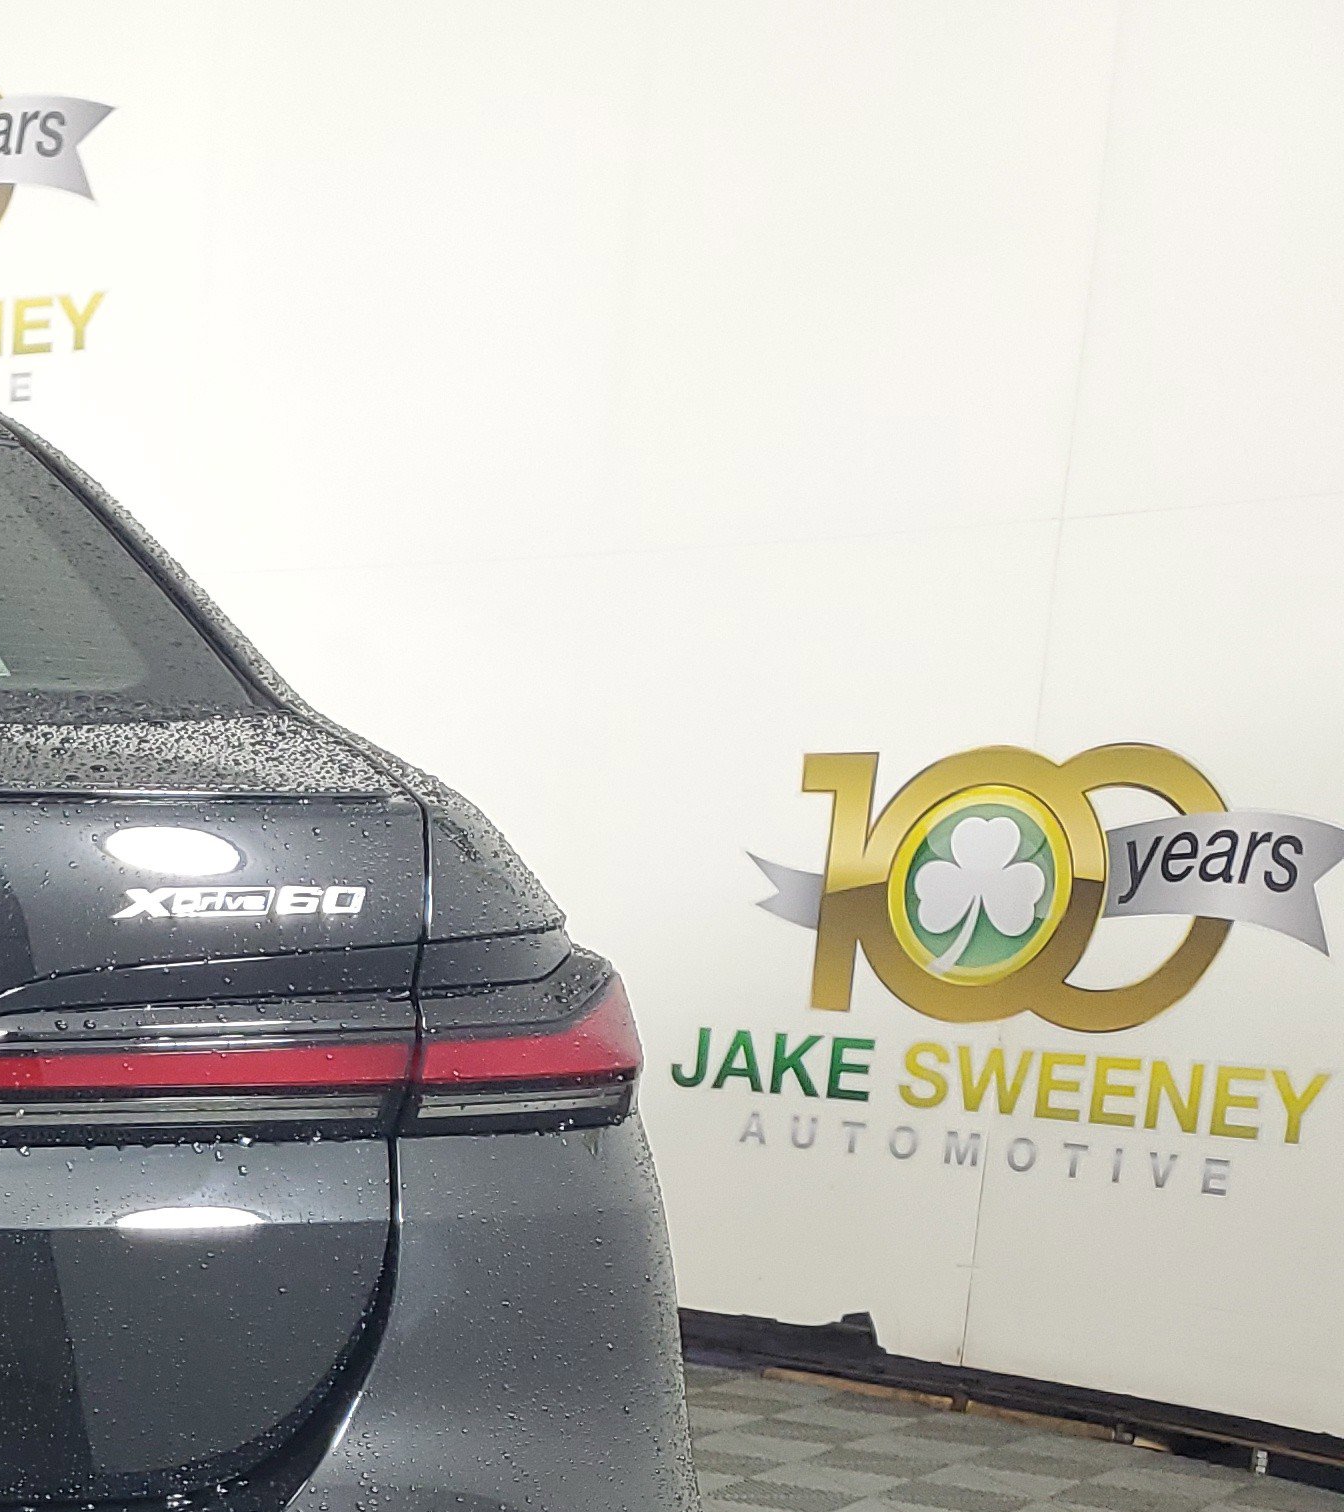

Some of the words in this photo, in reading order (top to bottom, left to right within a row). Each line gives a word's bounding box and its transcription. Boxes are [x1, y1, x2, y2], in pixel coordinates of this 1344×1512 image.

[1118, 827, 1304, 905] years
[671, 1027, 876, 1102] JAKE
[898, 1041, 1330, 1145] SWEENEY
[740, 1110, 1231, 1197] AUTOMOTIVE
